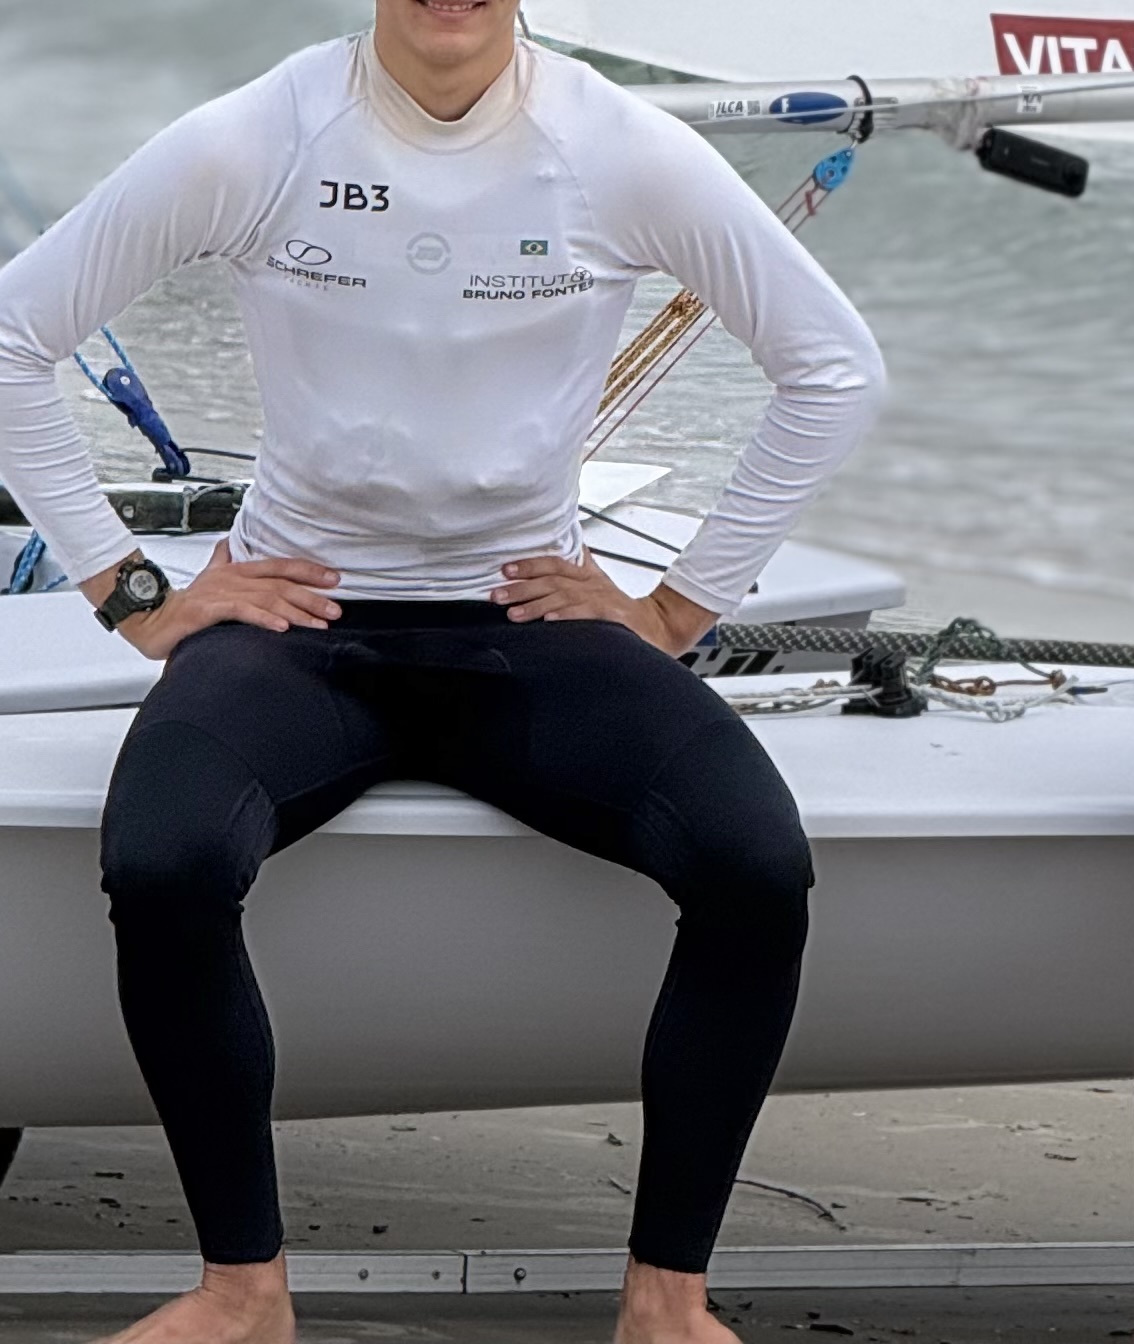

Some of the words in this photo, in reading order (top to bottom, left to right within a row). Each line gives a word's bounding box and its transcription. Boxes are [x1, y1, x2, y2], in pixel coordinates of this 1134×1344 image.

[716, 101, 744, 113] ILCA
[319, 180, 390, 212] JB3
[266, 255, 367, 289] SCHAEFER
[463, 289, 526, 300] BRUNO
[531, 278, 594, 299] FONTES
